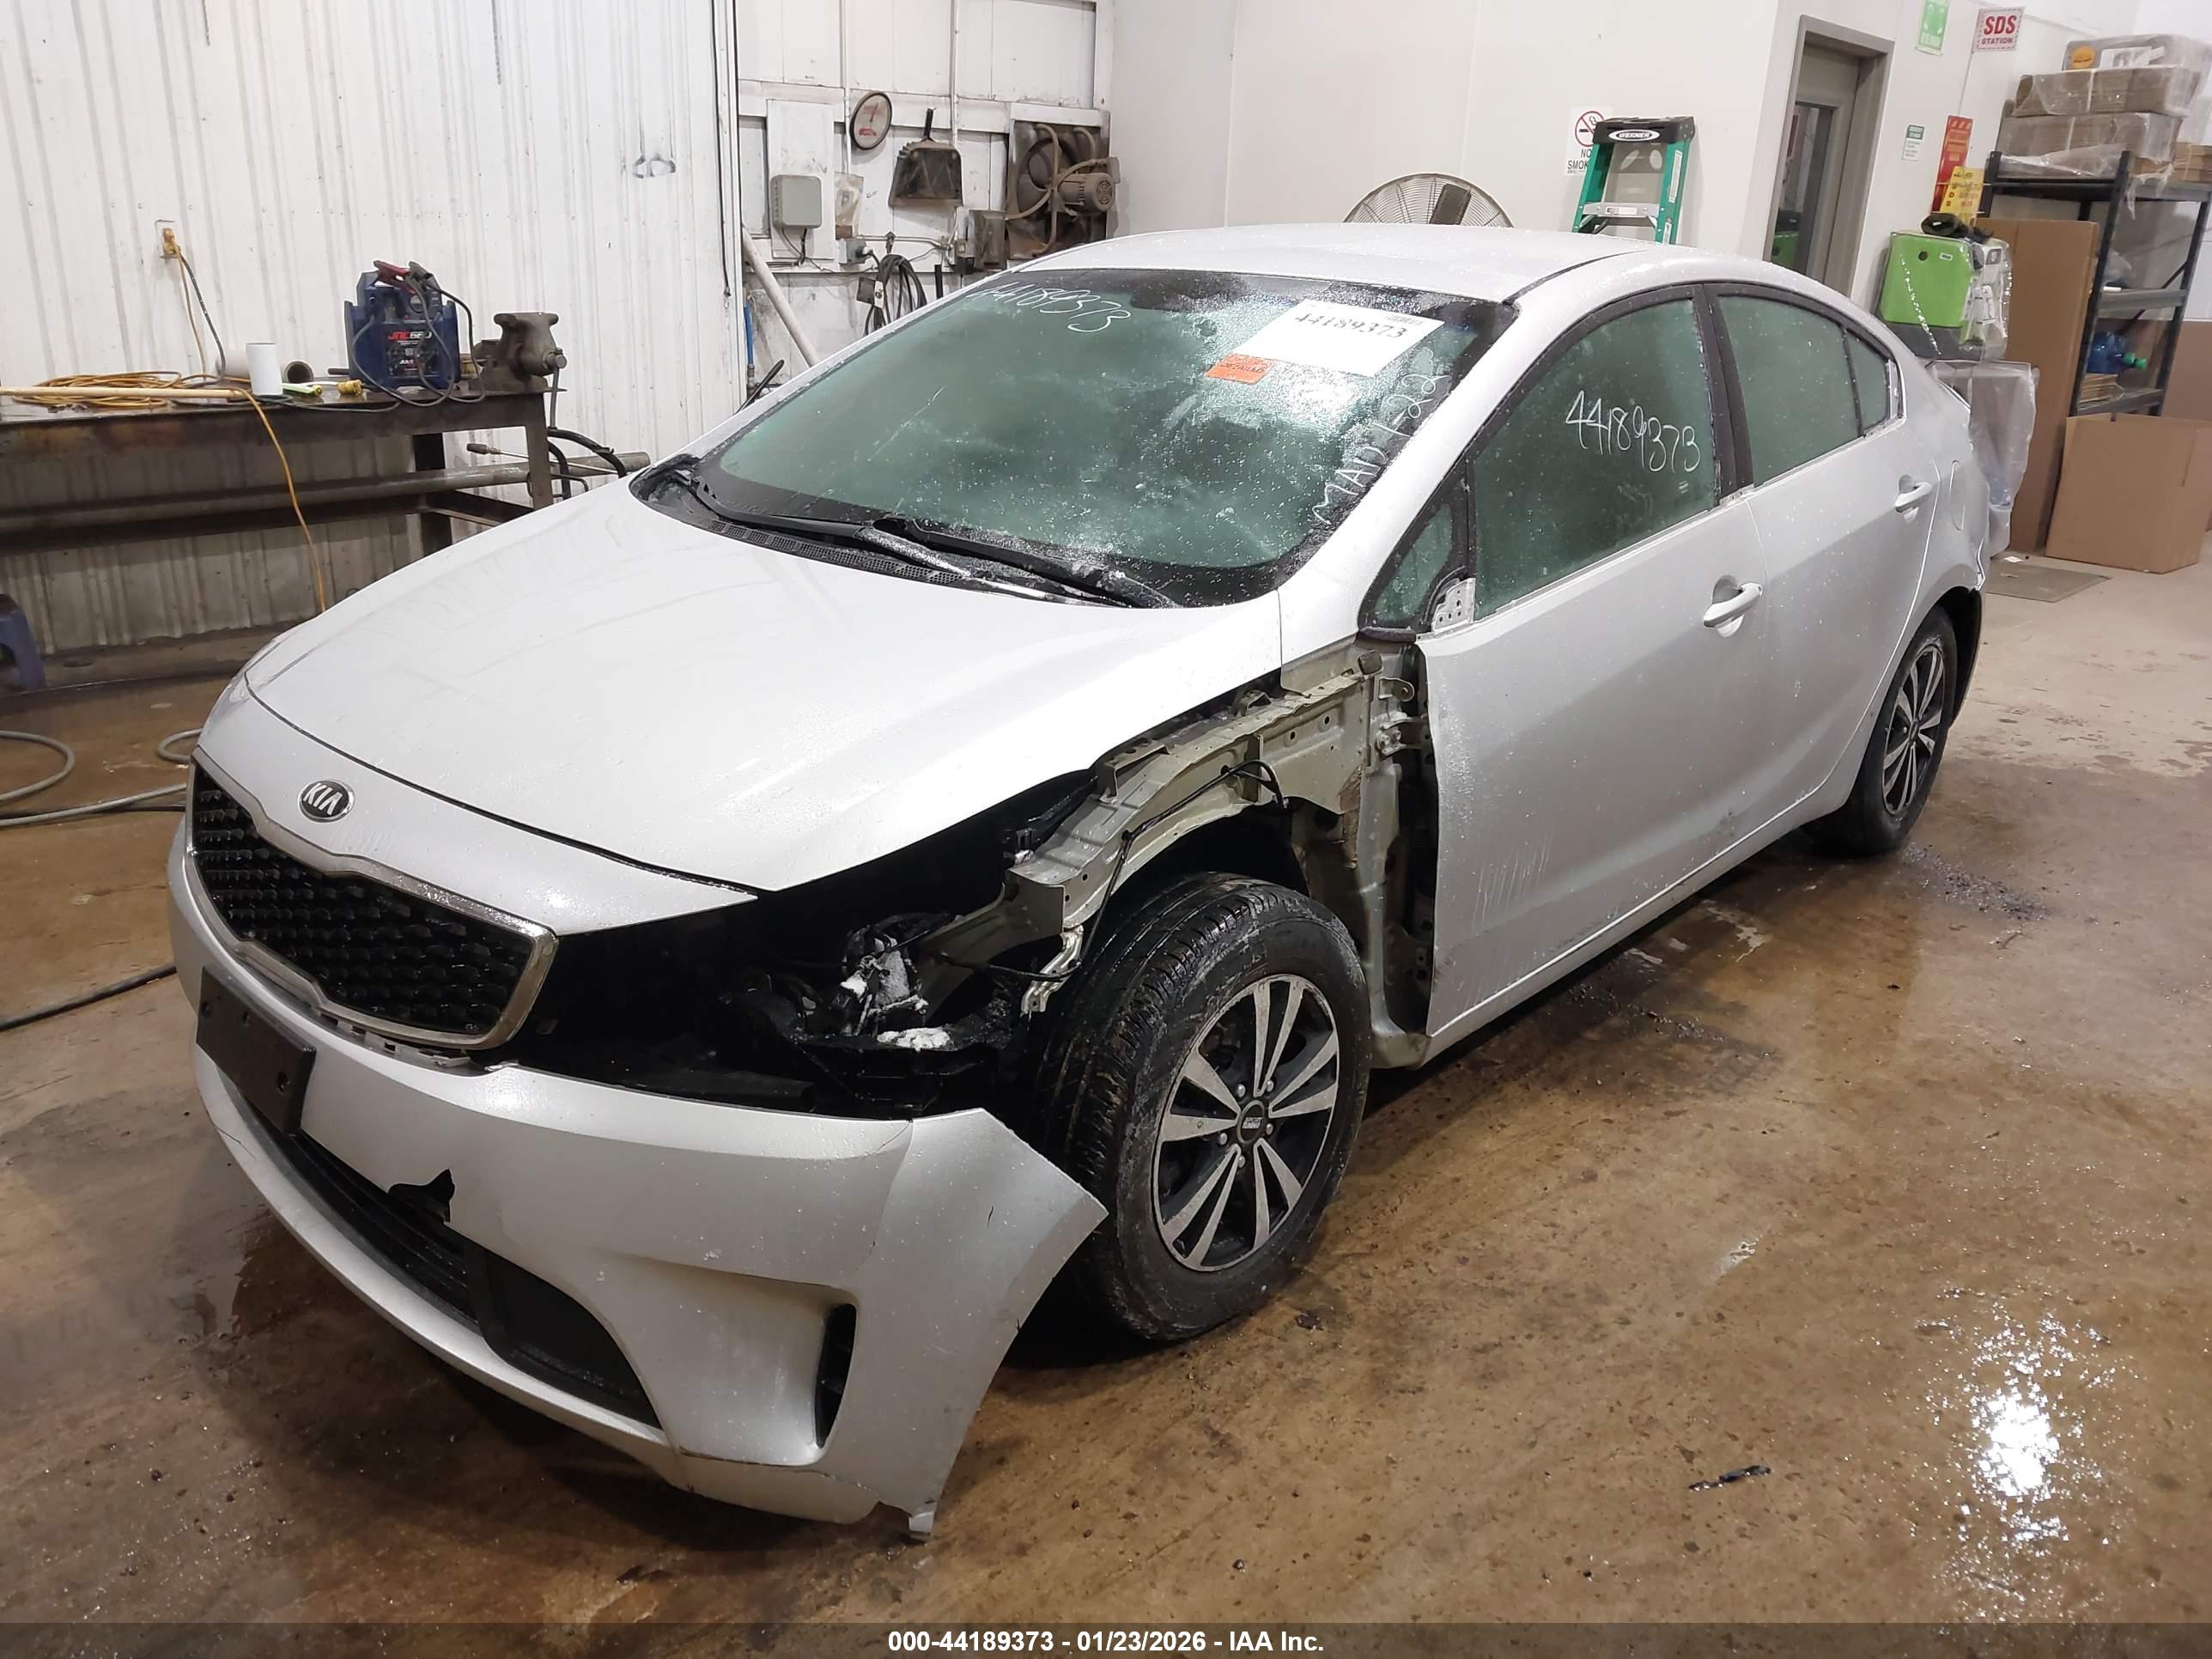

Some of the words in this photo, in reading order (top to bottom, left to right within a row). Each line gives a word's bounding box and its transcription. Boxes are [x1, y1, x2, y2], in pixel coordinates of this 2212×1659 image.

[1984, 15, 2017, 35] SDS
[1581, 149, 1592, 158] NO
[1567, 160, 1588, 170] SMOK
[1294, 313, 1408, 338] 44189373
[1565, 390, 1701, 473] 44189373
[303, 782, 343, 816] KIA
